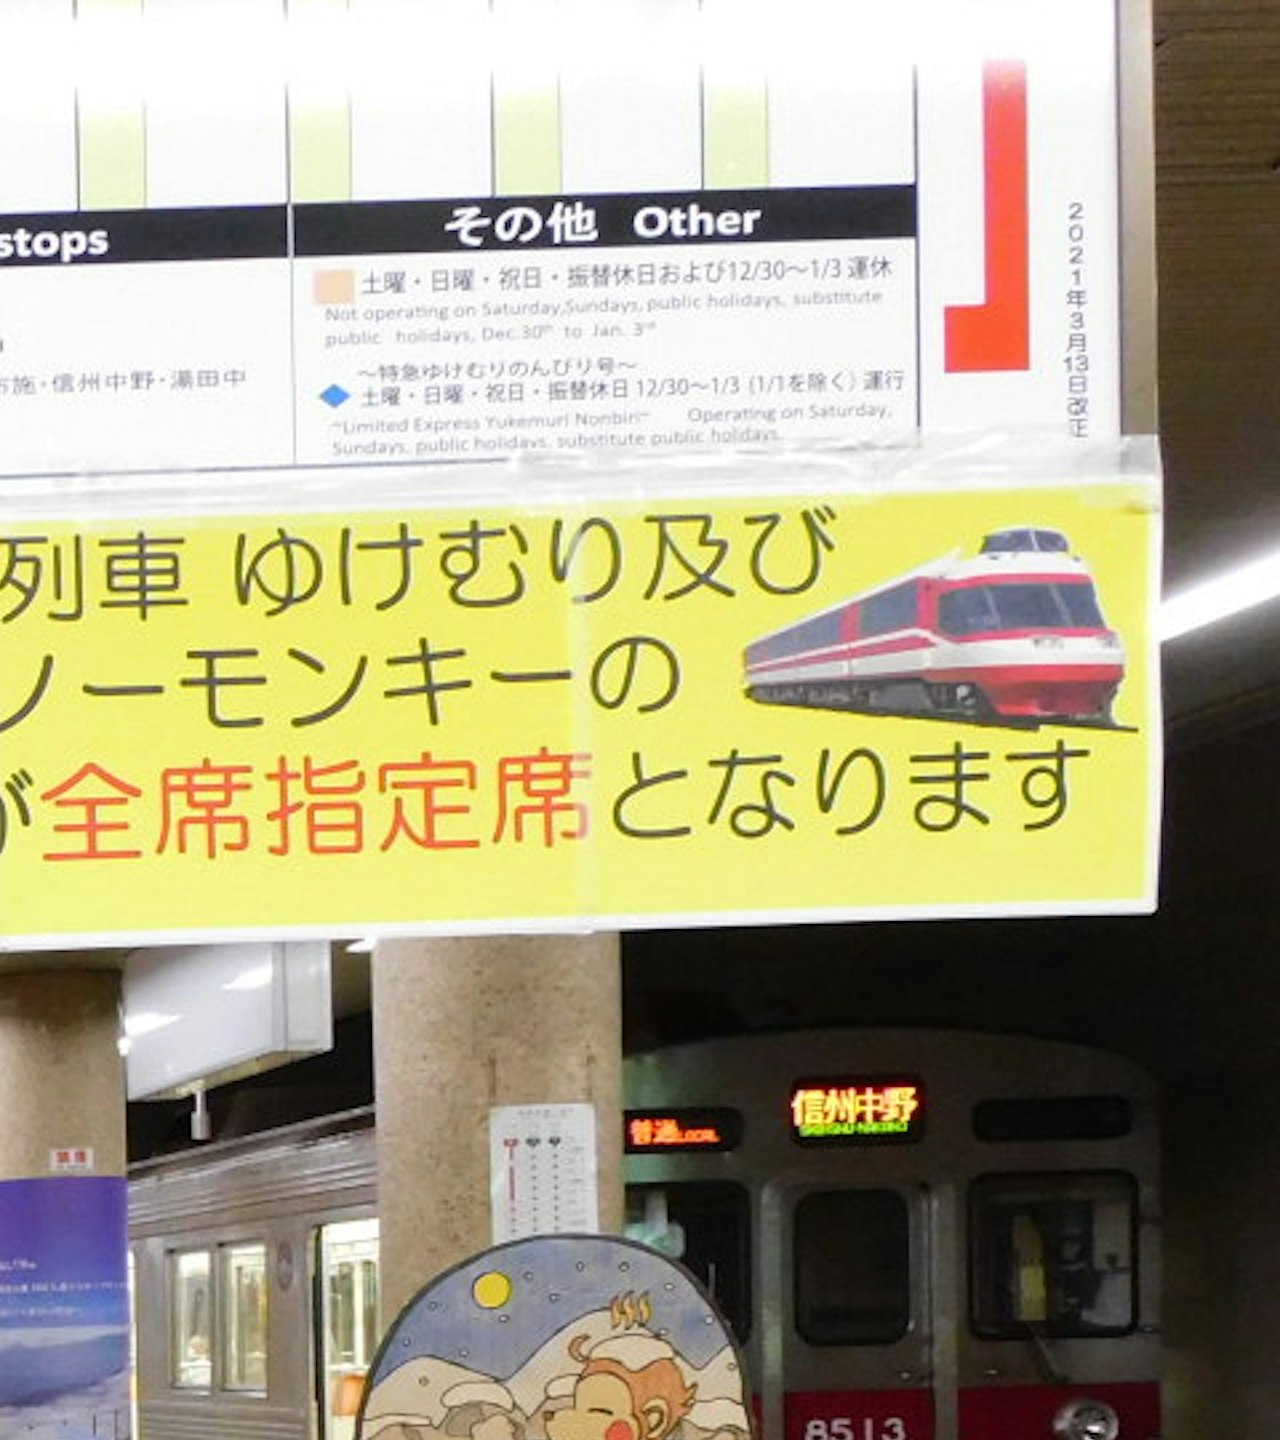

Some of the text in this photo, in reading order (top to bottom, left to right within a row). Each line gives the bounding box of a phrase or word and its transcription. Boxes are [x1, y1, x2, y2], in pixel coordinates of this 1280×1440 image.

[445, 202, 760, 246] その他 Other
[230, 511, 839, 611] ゆけむり及び
[791, 1086, 918, 1126] 信州中野
